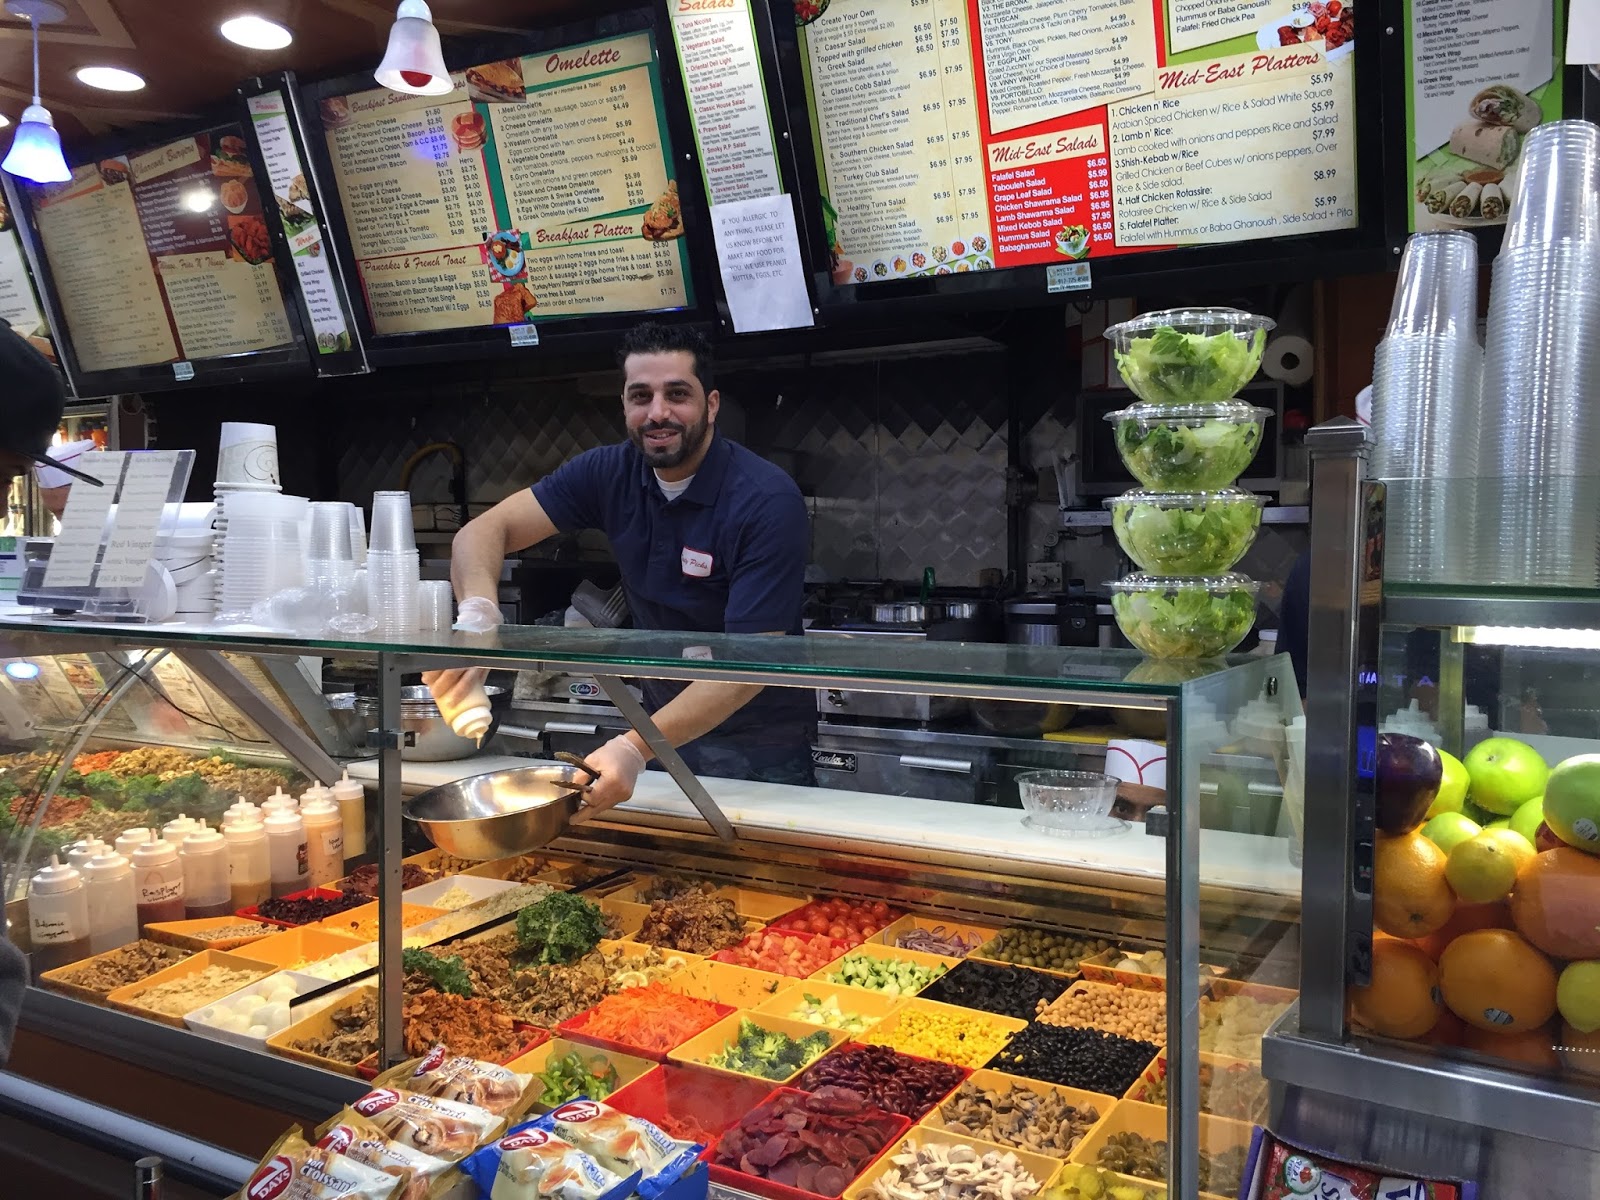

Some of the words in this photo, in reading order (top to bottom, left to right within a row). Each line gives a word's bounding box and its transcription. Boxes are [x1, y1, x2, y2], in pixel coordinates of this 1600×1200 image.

[821, 15, 841, 26] Create
[842, 12, 858, 22] Your
[858, 8, 874, 19] Own
[1176, 10, 1207, 24] Hummus
[1208, 10, 1216, 18] or
[1217, 5, 1235, 17] Baba
[1236, 0, 1272, 13] Ganoush:
[914, 24, 931, 32] $6.50
[940, 18, 957, 27] $7.50
[1176, 21, 1200, 34] Falafel:
[1201, 18, 1218, 29] Fried
[1219, 14, 1240, 26] Chick
[1241, 11, 1255, 22] Pea
[817, 51, 839, 64] Topped
[840, 48, 855, 58] with
[855, 44, 876, 57] grilled
[876, 40, 903, 52] chicken
[825, 40, 846, 52] Caesar
[847, 37, 866, 47] Salad
[546, 48, 621, 73] Omelette
[1159, 63, 1245, 89] Mid-East
[1252, 52, 1320, 75] Platters
[1311, 72, 1333, 85] $5.99
[831, 85, 853, 96] Classic
[854, 82, 871, 92] Cobb
[872, 78, 891, 89] Salad
[1112, 116, 1142, 130] Arabian
[1144, 112, 1172, 127] Spiced
[1173, 106, 1208, 120] Chicken
[1209, 104, 1220, 115] w/
[1222, 102, 1240, 113] Rice
[1241, 100, 1249, 110] &
[1250, 96, 1276, 109] Salad
[1277, 92, 1302, 105] White
[1303, 88, 1332, 101] Sauce
[1118, 102, 1152, 116] Chicken
[1153, 101, 1160, 111] n'
[1162, 98, 1180, 110] Rice
[1312, 101, 1334, 113] $5.99
[1120, 130, 1143, 142] Lamb
[1152, 126, 1174, 138] Rice:
[1312, 129, 1335, 140] $7.99
[839, 147, 868, 159] Southern
[868, 143, 894, 154] Chicken
[895, 140, 914, 150] Salad
[993, 142, 1052, 162] Mid-East
[1056, 135, 1098, 153] Salads
[1087, 158, 1106, 168] $6.50
[992, 171, 1014, 182] Falafel
[1014, 168, 1036, 179] Salad
[1088, 169, 1107, 178] $5.99
[1314, 170, 1336, 181] $8.99
[993, 180, 1024, 192] Tabouleh
[1025, 178, 1046, 188] Salad
[994, 192, 1014, 204] Grape
[1015, 190, 1031, 200] Leaf
[1032, 187, 1052, 198] Salad
[995, 201, 1022, 212] Chicken
[1023, 196, 1060, 209] Shawrama
[1061, 193, 1083, 204] Salad
[1125, 194, 1140, 205] Half
[1141, 190, 1174, 203] Chicken
[1175, 185, 1213, 199] Rotassire:
[1315, 196, 1337, 207] $5.99
[847, 202, 870, 213] Healthy
[870, 199, 887, 209] Tuna
[888, 197, 906, 207] Salad
[743, 213, 767, 222] ALLERGIC
[937, 215, 953, 223] $6.95
[961, 212, 978, 220] $7.95
[996, 213, 1015, 223] Lamb
[1016, 208, 1053, 220] Shawarma
[1054, 205, 1075, 215] Salad
[1092, 212, 1110, 221] $7.95
[755, 224, 773, 232] PLEASE
[997, 223, 1017, 233] Mixed
[1018, 220, 1041, 230] Kebob
[1042, 217, 1063, 227] Salad
[1126, 218, 1152, 230] Falafel
[1152, 215, 1179, 227] Platter:
[536, 227, 589, 242] Breakfast
[593, 224, 633, 239] Platter
[753, 237, 772, 245] BEFORE
[998, 231, 1029, 243] Hummus
[1030, 229, 1050, 239] Salad
[999, 239, 1051, 254] Babaghanoush
[364, 259, 401, 272] Pancakes
[413, 257, 440, 269] French
[442, 255, 466, 265] Toast
[766, 259, 787, 267] PEANUT
[360, 1089, 397, 1110] 7
[366, 1096, 399, 1112] DAYS
[511, 1139, 544, 1148] DAYS
[250, 1158, 288, 1196] 7
[258, 1168, 290, 1200] DAYS
